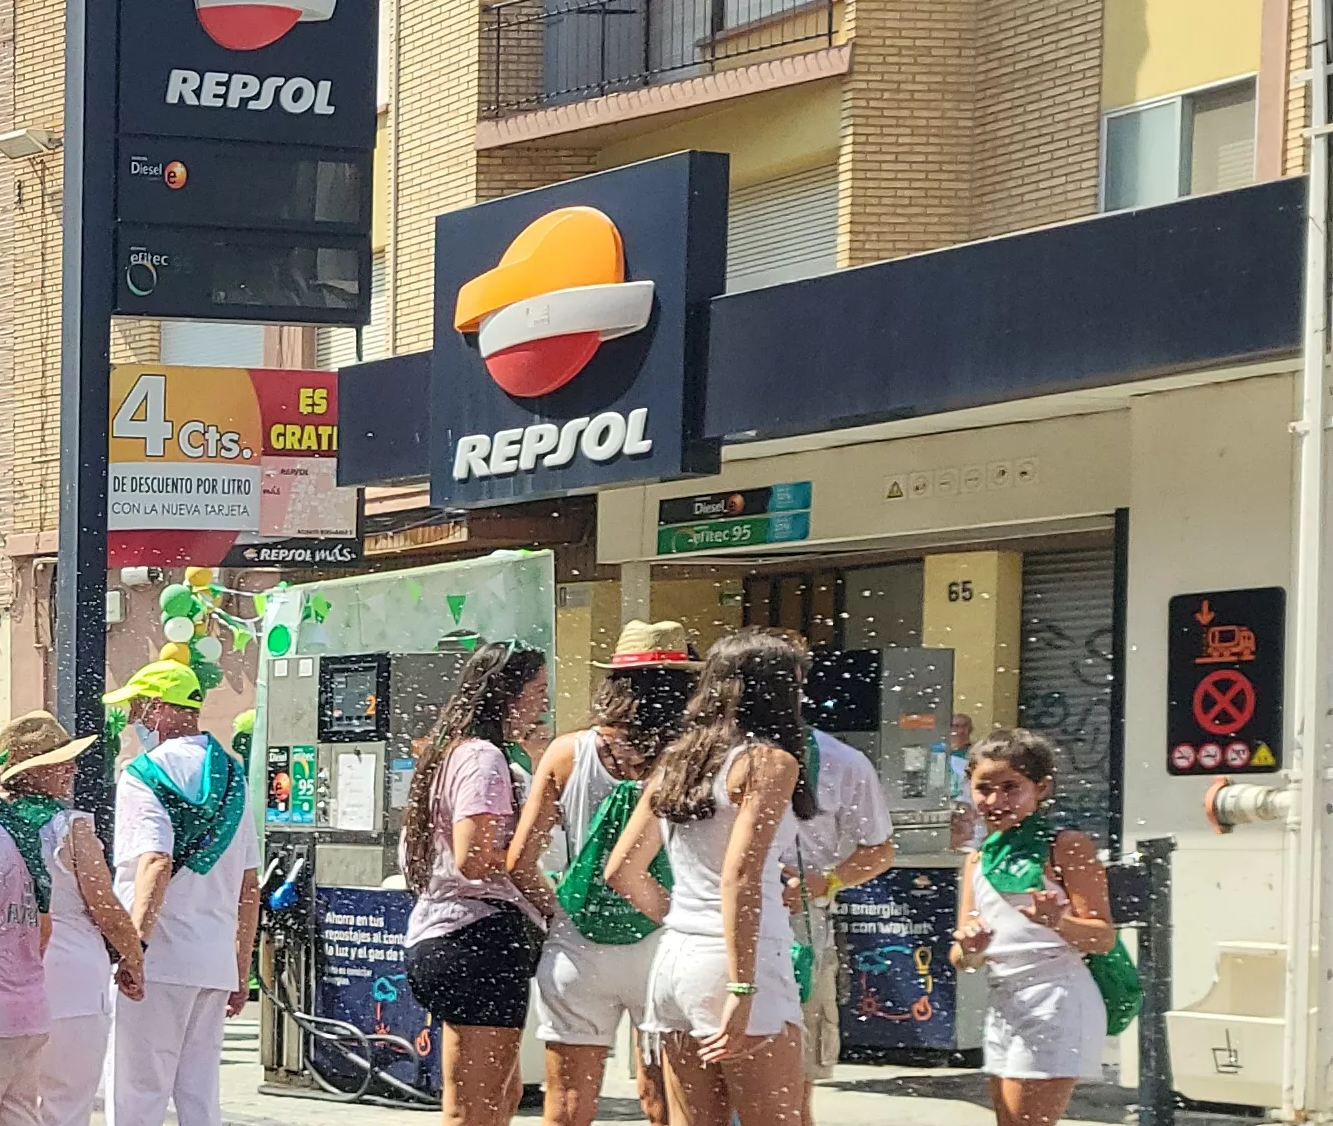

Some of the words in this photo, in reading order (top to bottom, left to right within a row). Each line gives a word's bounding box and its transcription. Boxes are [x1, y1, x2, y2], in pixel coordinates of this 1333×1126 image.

[165, 68, 336, 115] REPSOL
[131, 161, 163, 175] Diesel
[130, 251, 169, 266] efitec
[299, 388, 328, 414] ES
[112, 374, 173, 457] 4
[178, 420, 253, 459] Cts.
[270, 423, 338, 451] GRATI
[452, 407, 653, 481] REPSOL
[113, 476, 127, 492] DE
[131, 476, 192, 494] DESCUENTO
[196, 477, 218, 495] POR
[222, 477, 251, 495] LITRO
[112, 502, 141, 515] CON
[144, 503, 159, 515] LA
[162, 503, 201, 516] NUEVA
[204, 504, 250, 516] TARJETA
[694, 500, 725, 514] Diesel
[732, 525, 751, 541] 95
[260, 548, 312, 561] REPSOL
[948, 580, 974, 602] 65
[366, 694, 377, 715] 2
[298, 779, 314, 796] 95
[325, 911, 355, 924] Ahora
[356, 915, 368, 926] en
[369, 914, 384, 927] tus
[325, 928, 371, 945] repostajes
[851, 922, 876, 934] con
[335, 944, 349, 957] luz
[351, 946, 358, 960] y
[358, 946, 367, 958] el
[368, 948, 385, 962] gas
